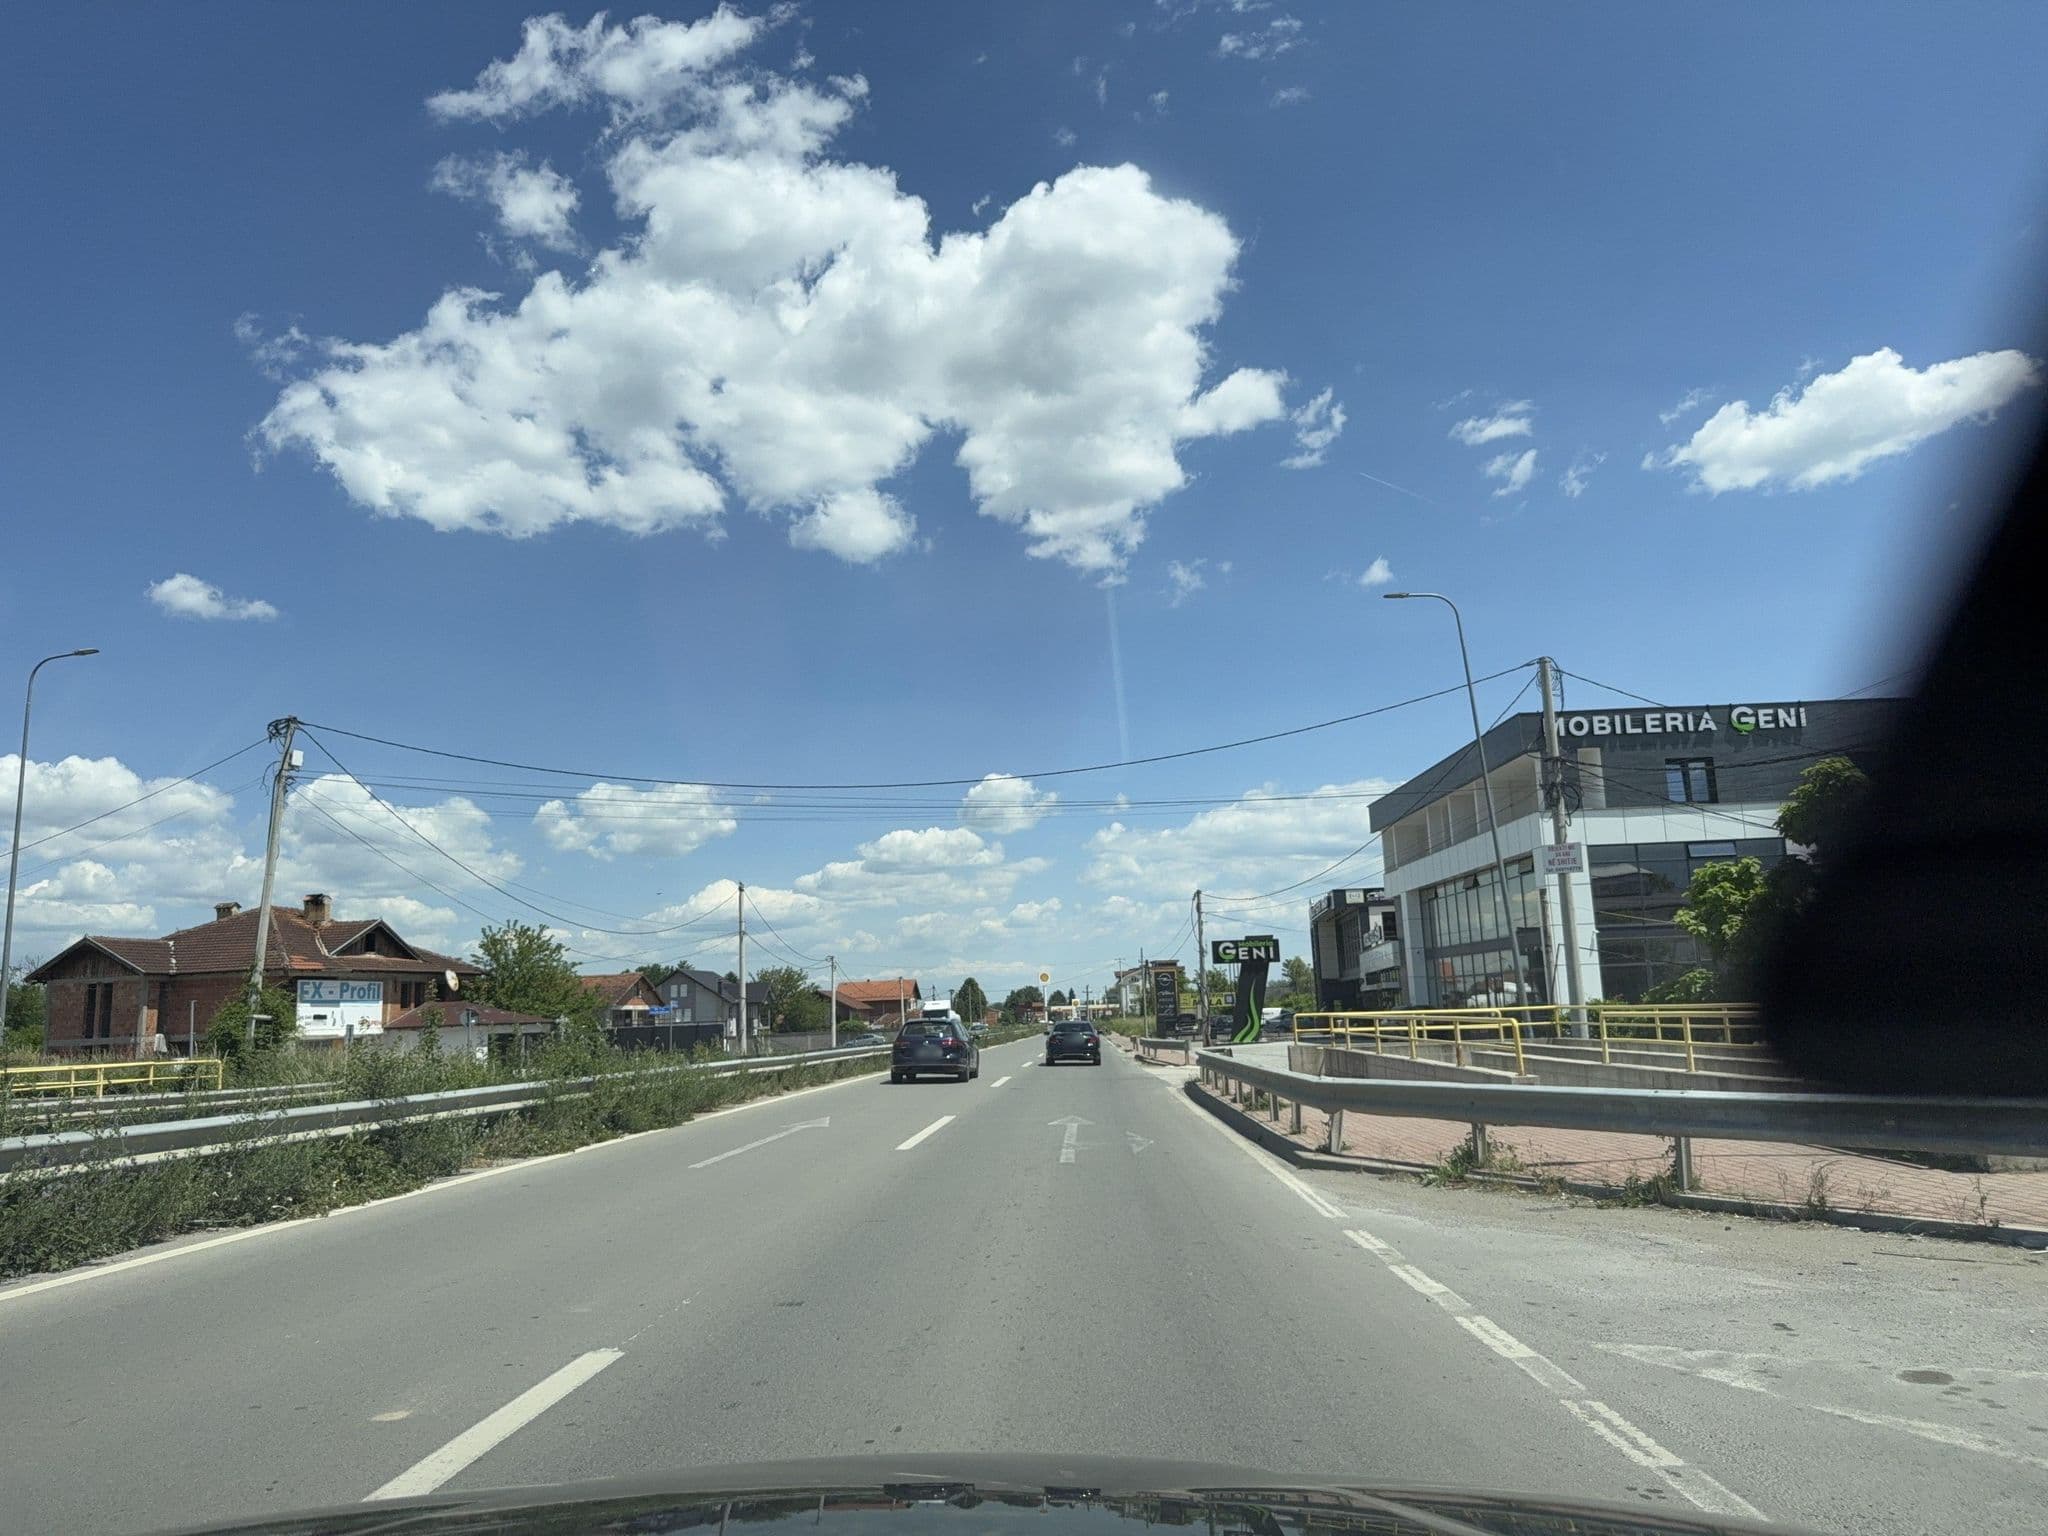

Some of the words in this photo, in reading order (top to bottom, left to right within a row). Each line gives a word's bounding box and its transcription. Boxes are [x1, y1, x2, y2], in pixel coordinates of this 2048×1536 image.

[1731, 706, 1807, 734] GENI
[1219, 942, 1274, 960] GENI
[340, 982, 381, 999] Profil
